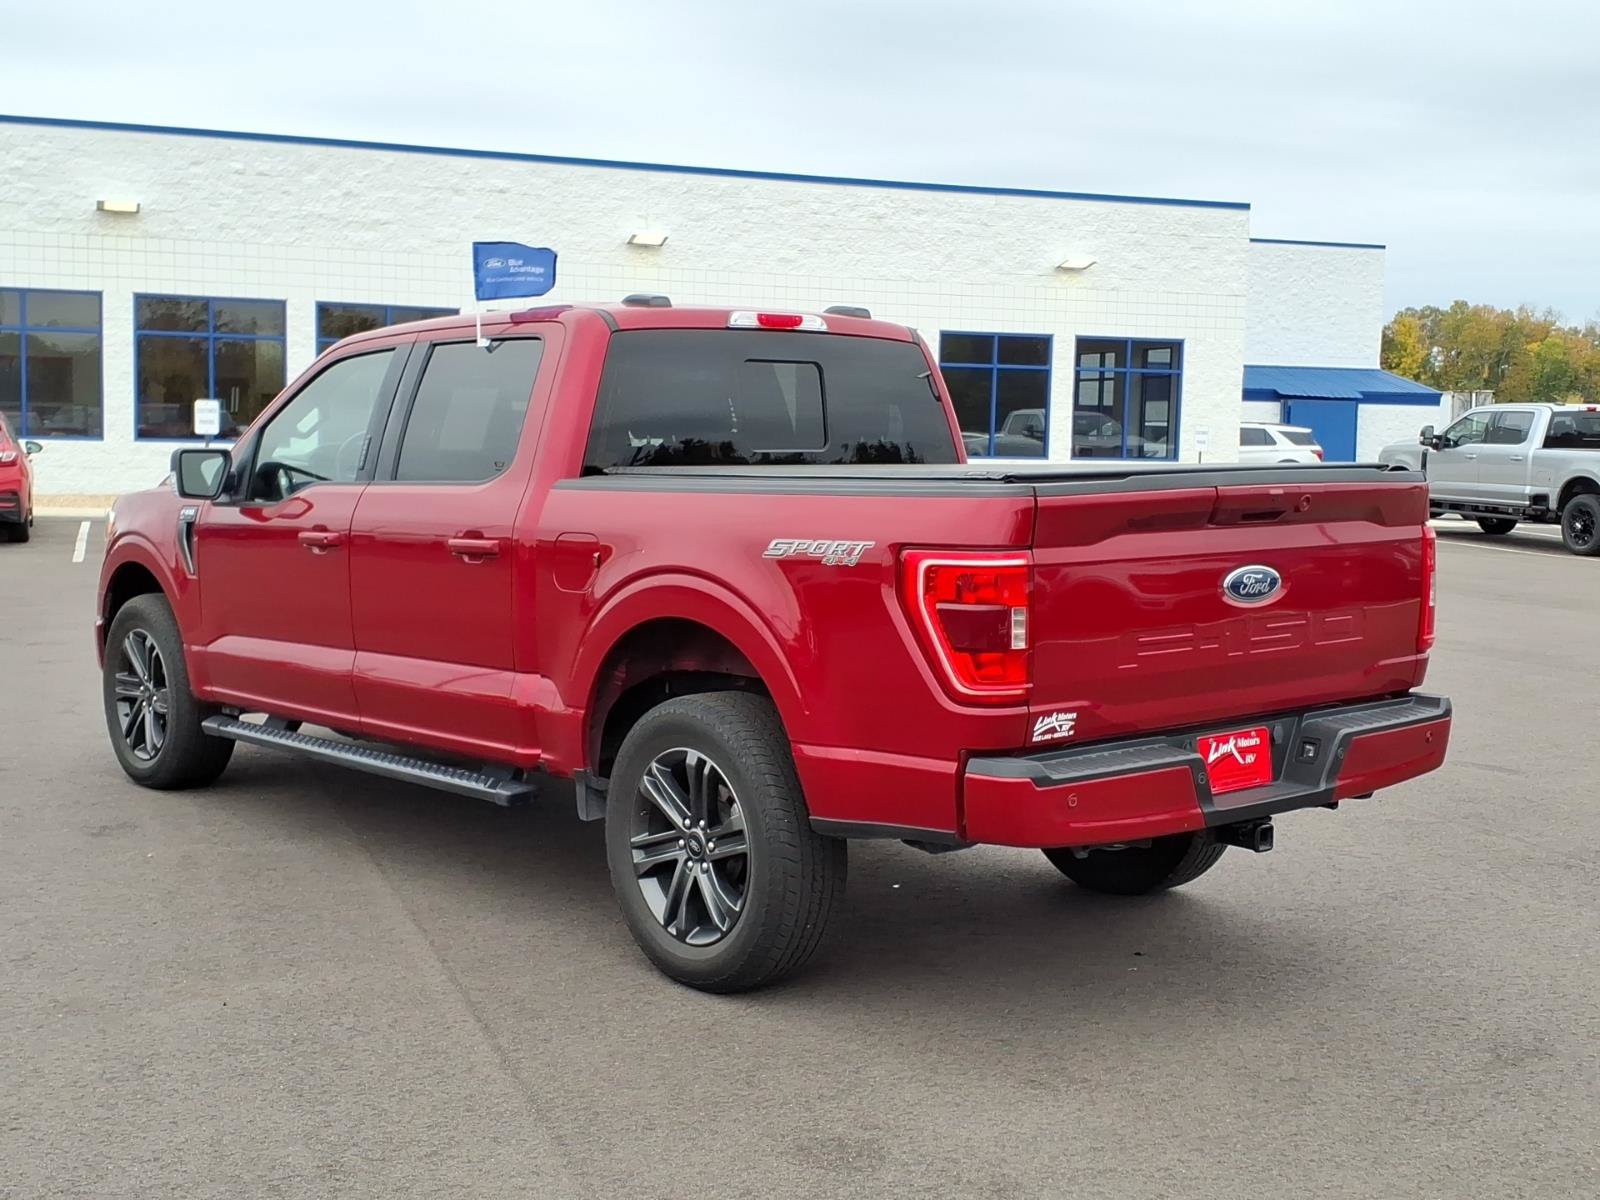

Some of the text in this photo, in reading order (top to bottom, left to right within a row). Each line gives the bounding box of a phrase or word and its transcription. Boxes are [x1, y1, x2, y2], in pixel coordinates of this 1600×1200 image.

[762, 539, 875, 558] SPORT
[1240, 573, 1270, 595] Ford
[1033, 711, 1077, 731] Link Motors
[1207, 736, 1260, 764] Link Motors
[1245, 753, 1257, 764] RV
